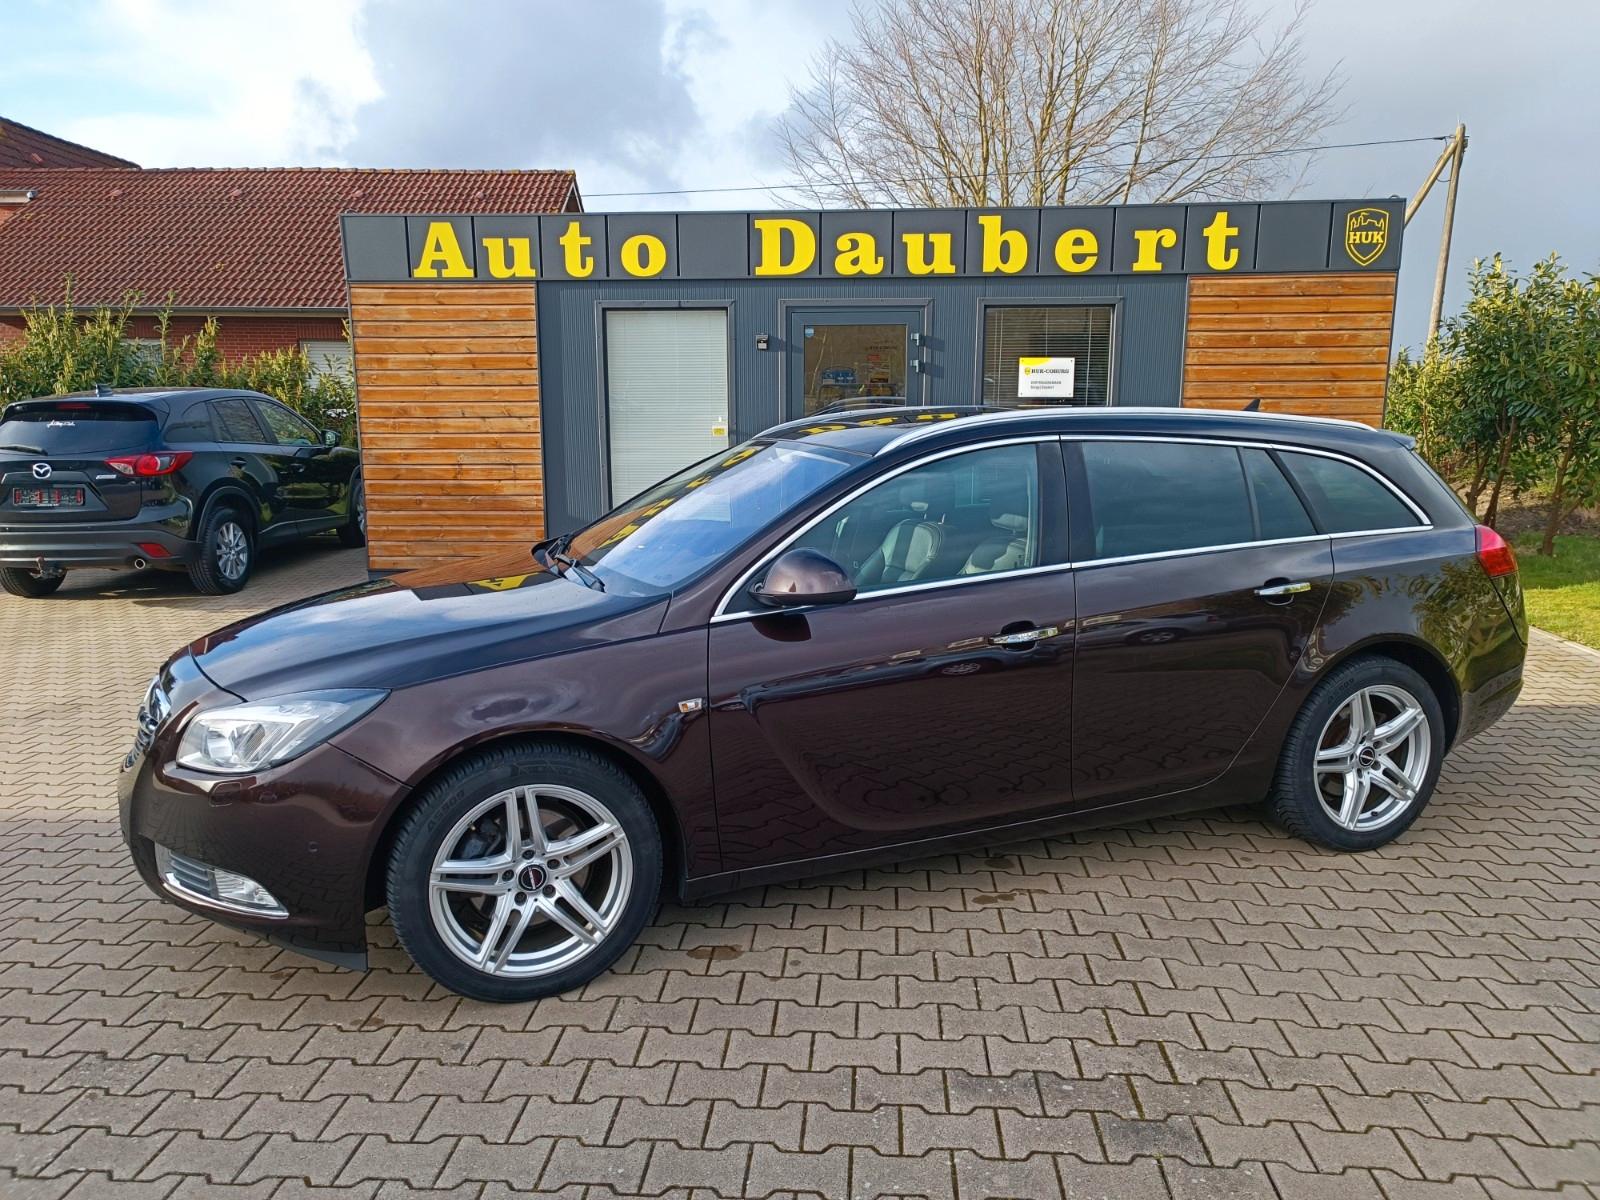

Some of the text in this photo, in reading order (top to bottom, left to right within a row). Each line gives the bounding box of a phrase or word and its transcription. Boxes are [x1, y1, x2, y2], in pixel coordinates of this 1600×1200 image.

[413, 211, 1240, 278] Auto Daubert
[1348, 231, 1385, 244] HUK
